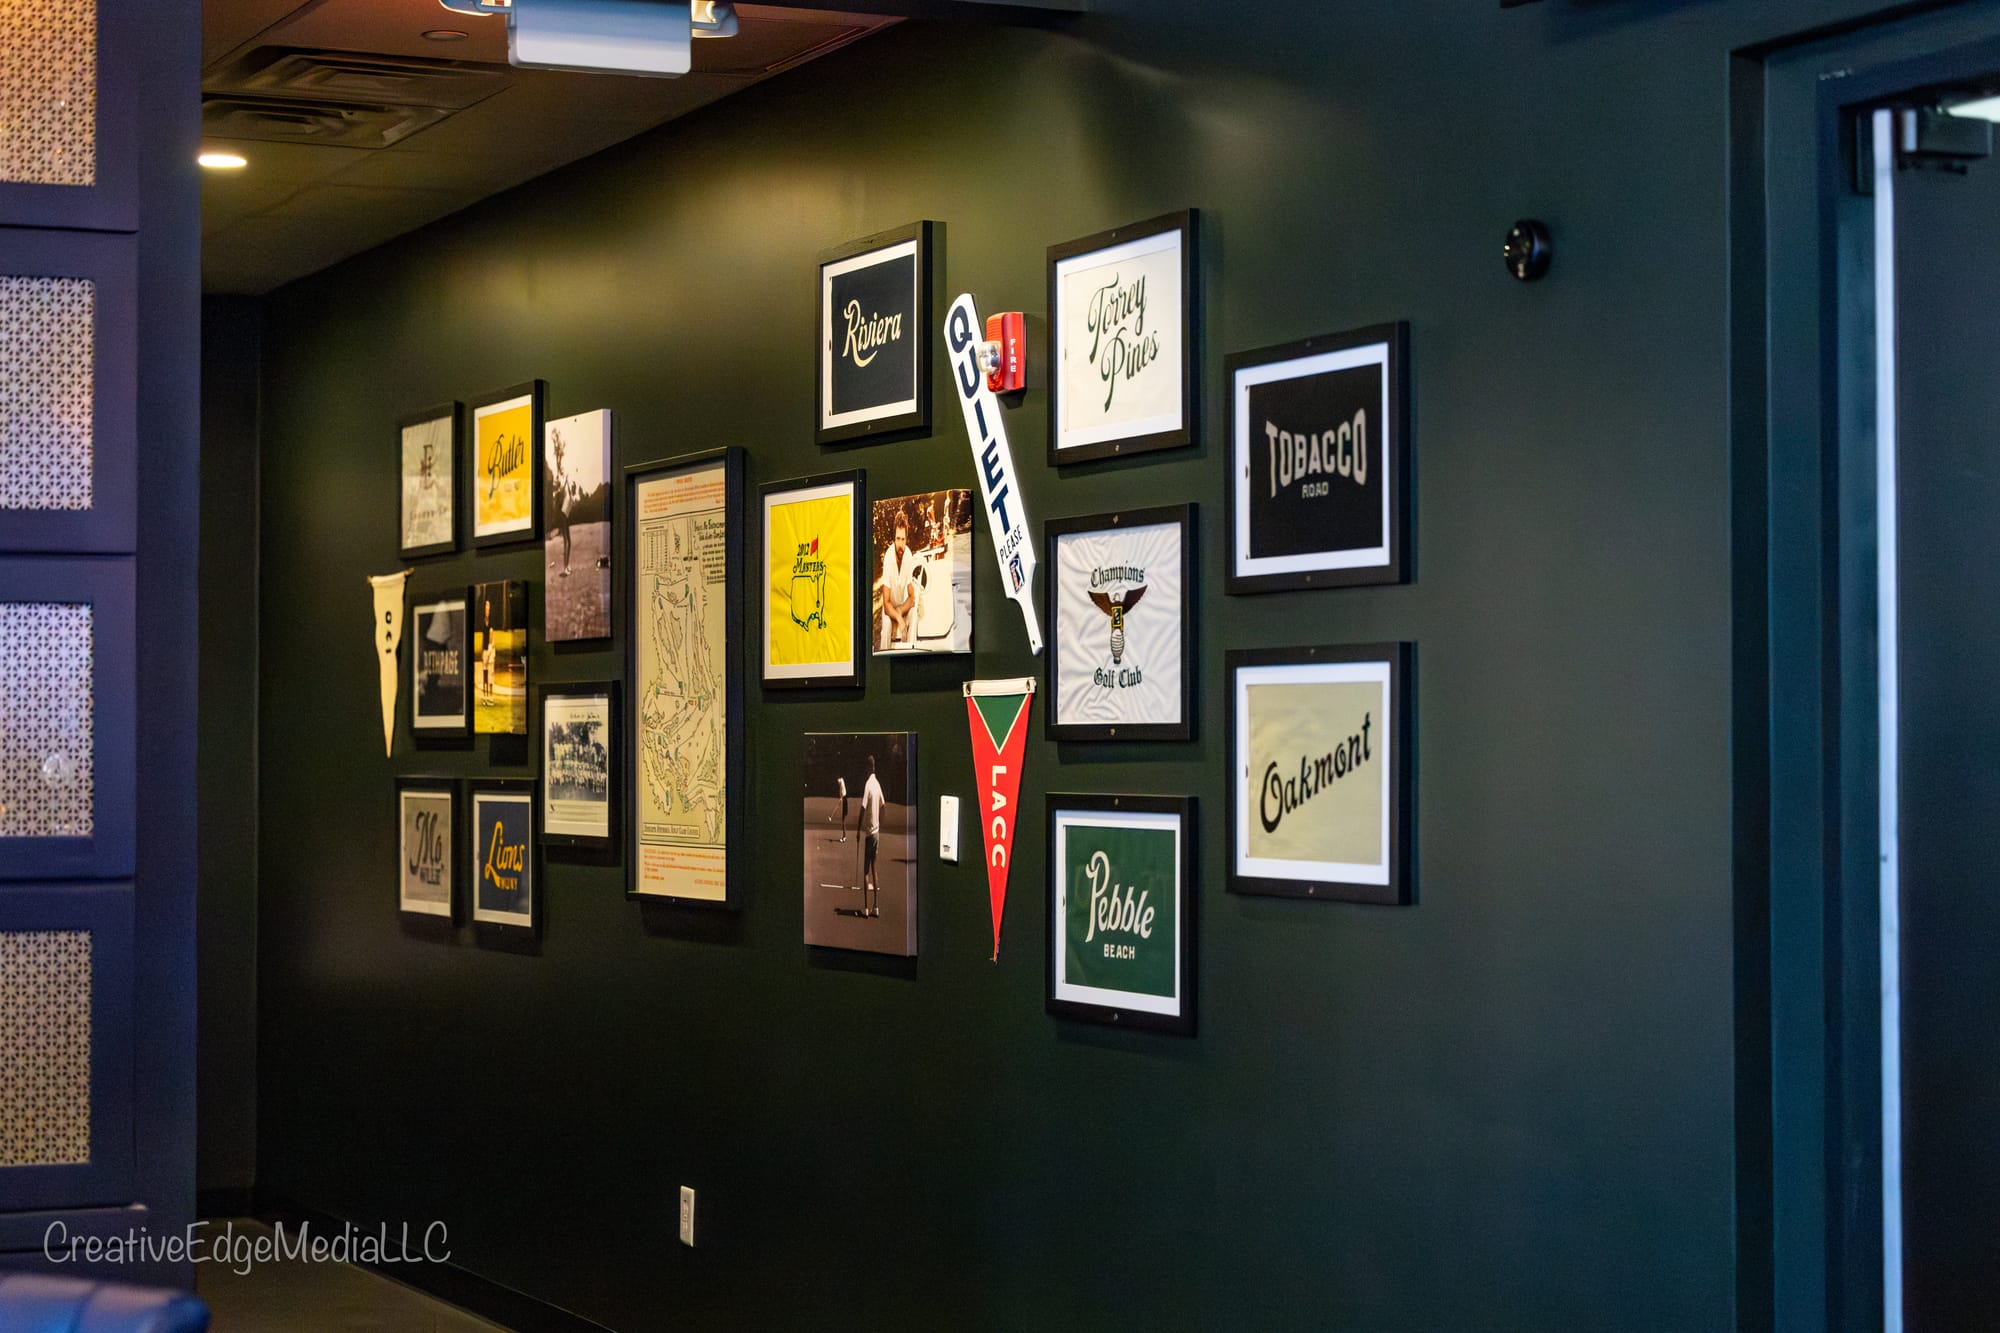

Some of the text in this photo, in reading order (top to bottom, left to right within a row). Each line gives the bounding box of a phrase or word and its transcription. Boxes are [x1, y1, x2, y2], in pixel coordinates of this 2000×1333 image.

[842, 299, 902, 368] Riviera
[1088, 272, 1147, 364] Torrey
[1100, 327, 1160, 413] Pines
[949, 305, 1009, 535] QUIET
[1265, 407, 1367, 499] TOBACCO
[487, 433, 524, 500] Butler
[1301, 481, 1329, 499] ROAD
[796, 542, 810, 557] 2012
[999, 524, 1023, 564] PLEASE
[1090, 562, 1146, 588] Champions
[1093, 665, 1143, 688] Golf Club
[1260, 711, 1371, 833] Oakmont
[991, 765, 1007, 868] LACC
[484, 821, 526, 888] Lions
[1085, 850, 1155, 943] Pebble
[1103, 943, 1136, 960] BEACH
